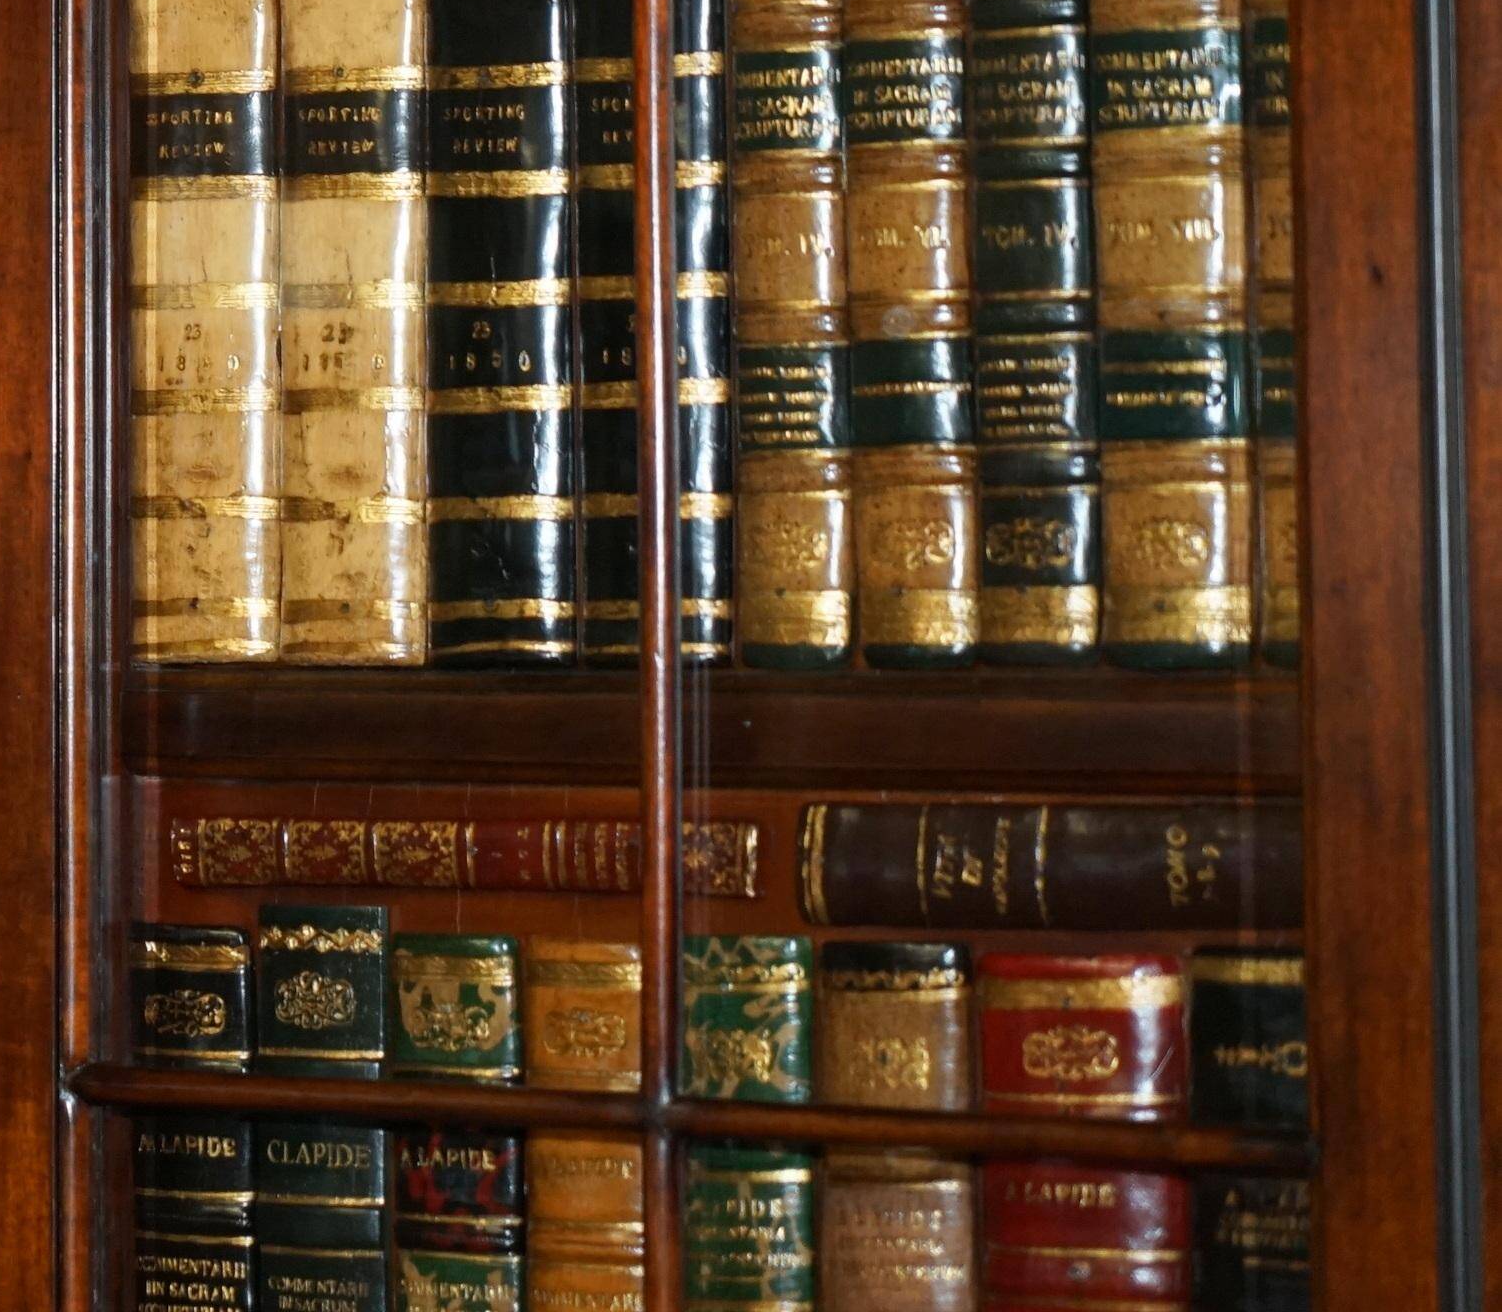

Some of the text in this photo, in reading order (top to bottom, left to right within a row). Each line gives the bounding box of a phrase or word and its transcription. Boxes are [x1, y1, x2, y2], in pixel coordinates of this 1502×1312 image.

[146, 108, 234, 126] SPORTING
[298, 105, 383, 123] SPORTING
[443, 103, 526, 121] SPORTING
[158, 140, 226, 159] REVIEW
[307, 138, 375, 156] REVIEW
[452, 136, 519, 154] REVIEW
